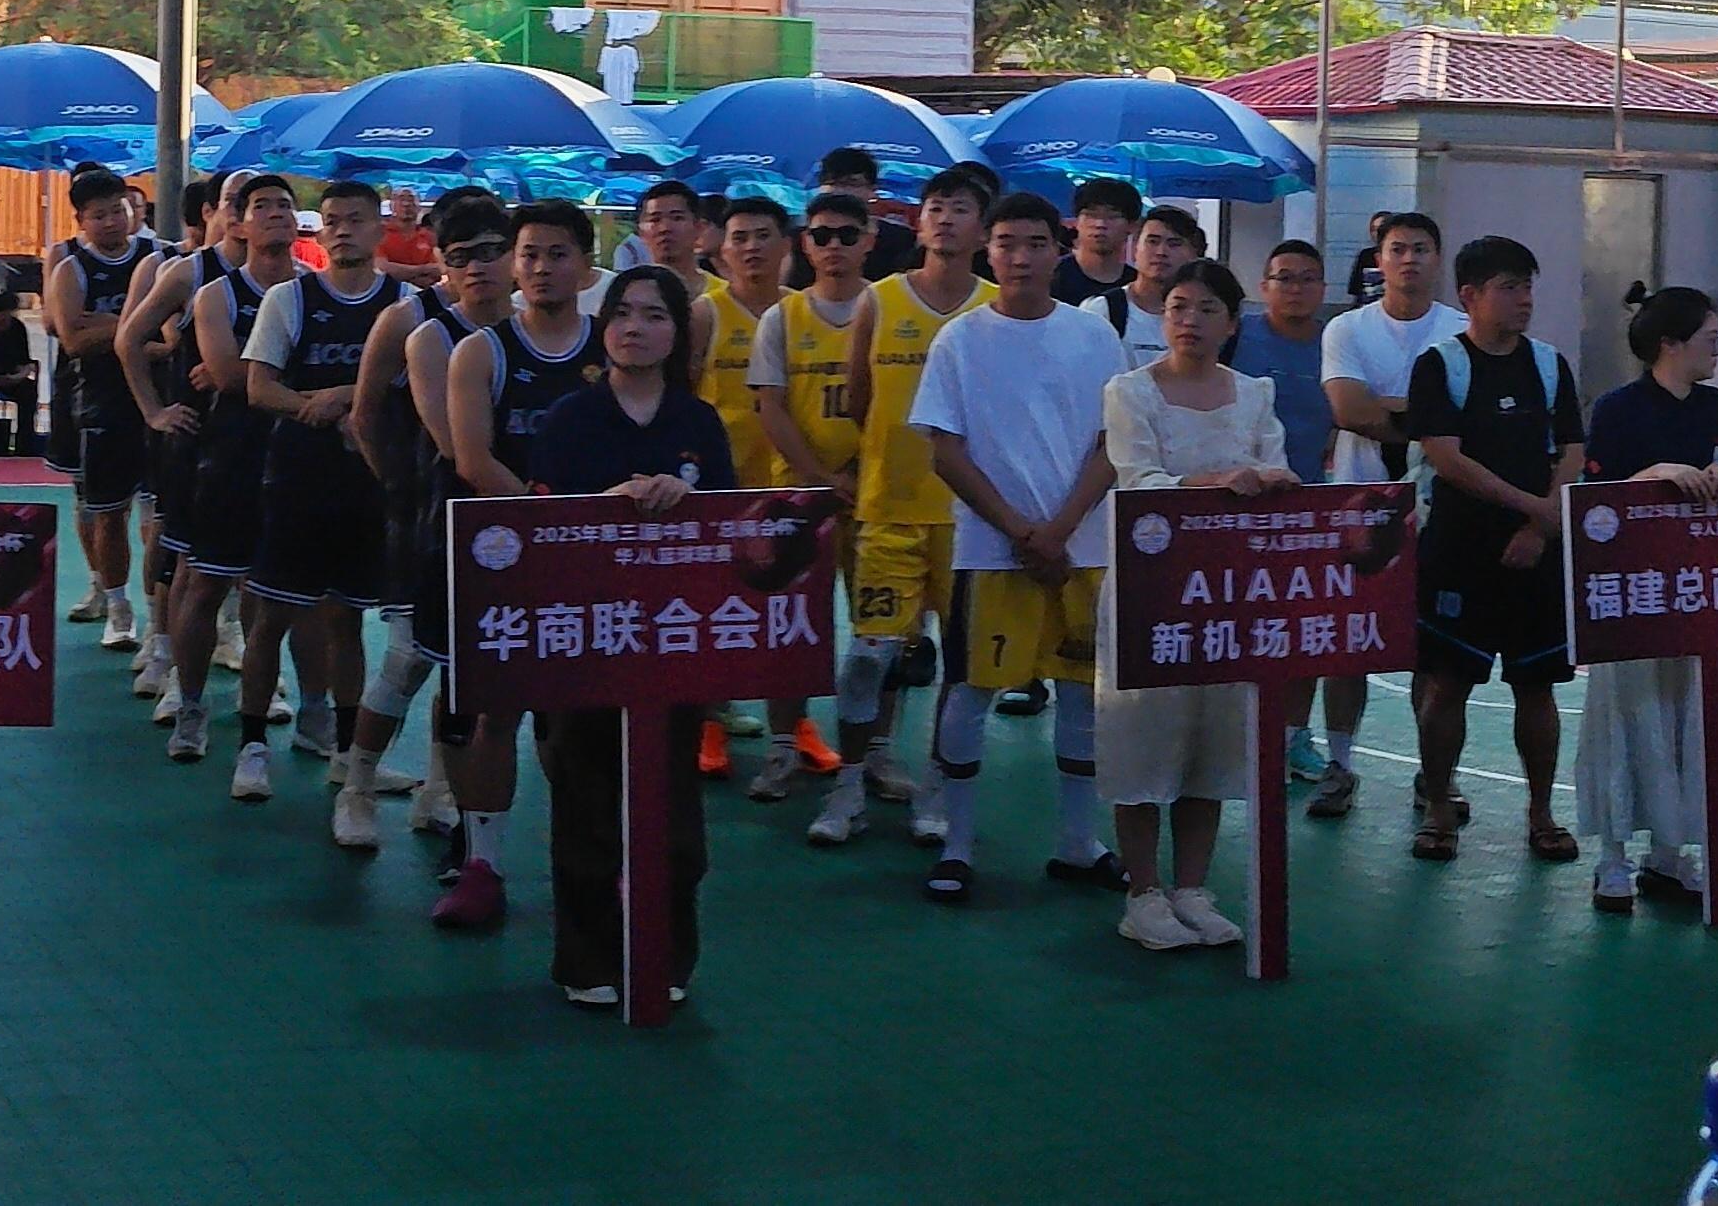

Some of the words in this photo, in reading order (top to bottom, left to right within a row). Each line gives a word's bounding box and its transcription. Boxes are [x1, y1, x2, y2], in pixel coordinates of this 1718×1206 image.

[1181, 563, 1357, 605] AIAAN
[478, 594, 819, 662] 华商联合会队
[1151, 611, 1386, 664] 新机场联队
